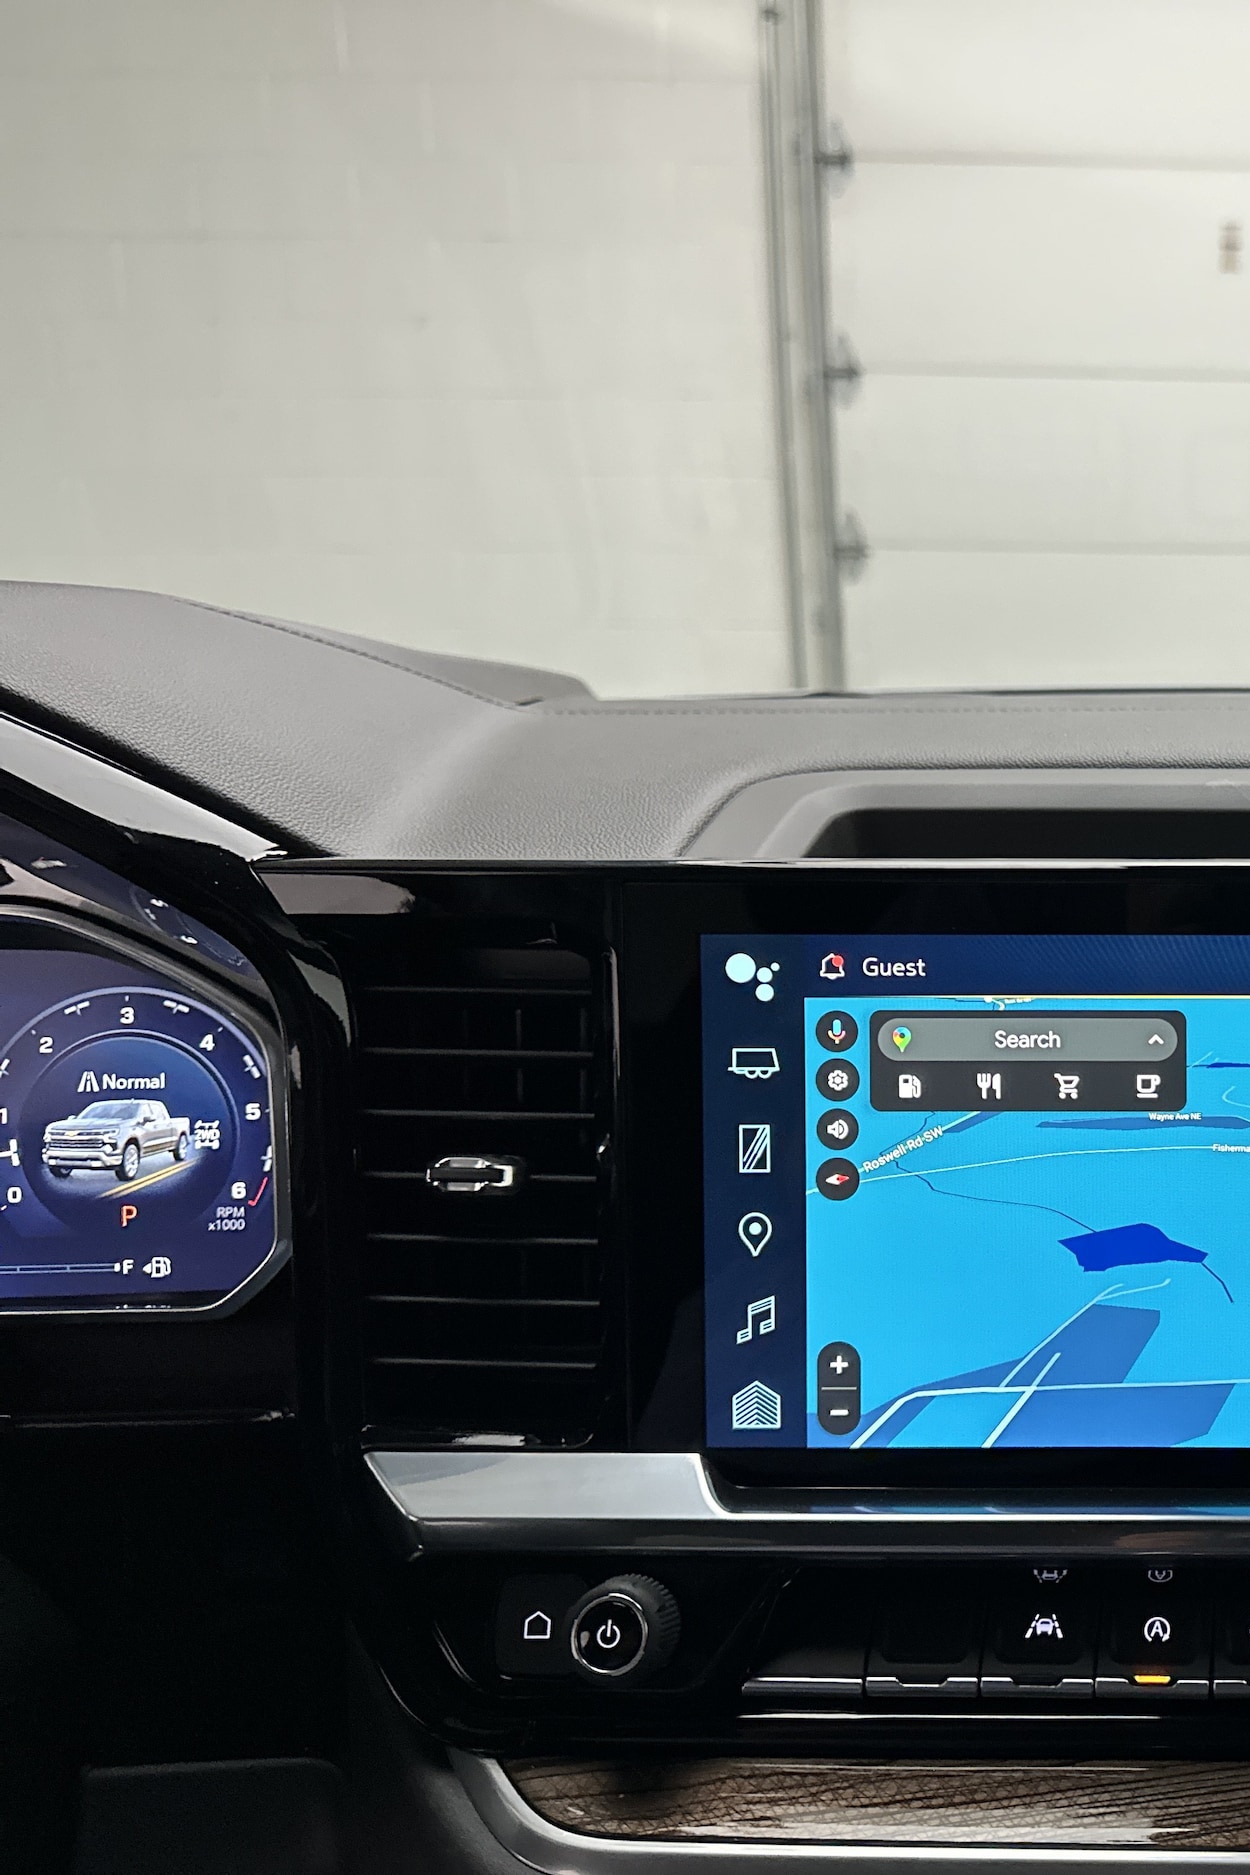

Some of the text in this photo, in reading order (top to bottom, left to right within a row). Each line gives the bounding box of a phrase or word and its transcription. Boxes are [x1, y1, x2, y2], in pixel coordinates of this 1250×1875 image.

[862, 957, 926, 977] Guest
[119, 1006, 135, 1024] 3
[39, 1037, 54, 1054] 2
[199, 1034, 215, 1051] 4
[994, 1030, 1061, 1049] Search
[103, 1073, 165, 1090] Normal
[0, 1108, 8, 1124] 1
[245, 1103, 261, 1120] 5
[1149, 1112, 1202, 1121] Wayne Ave NE
[194, 1129, 220, 1141] 2WD
[862, 1125, 944, 1173] Roswell Rd SW
[7, 1187, 22, 1204] 0
[231, 1181, 247, 1199] 6
[121, 1204, 138, 1227] P
[216, 1206, 245, 1218] RPM
[208, 1218, 246, 1231] x1000
[122, 1259, 134, 1274] F
